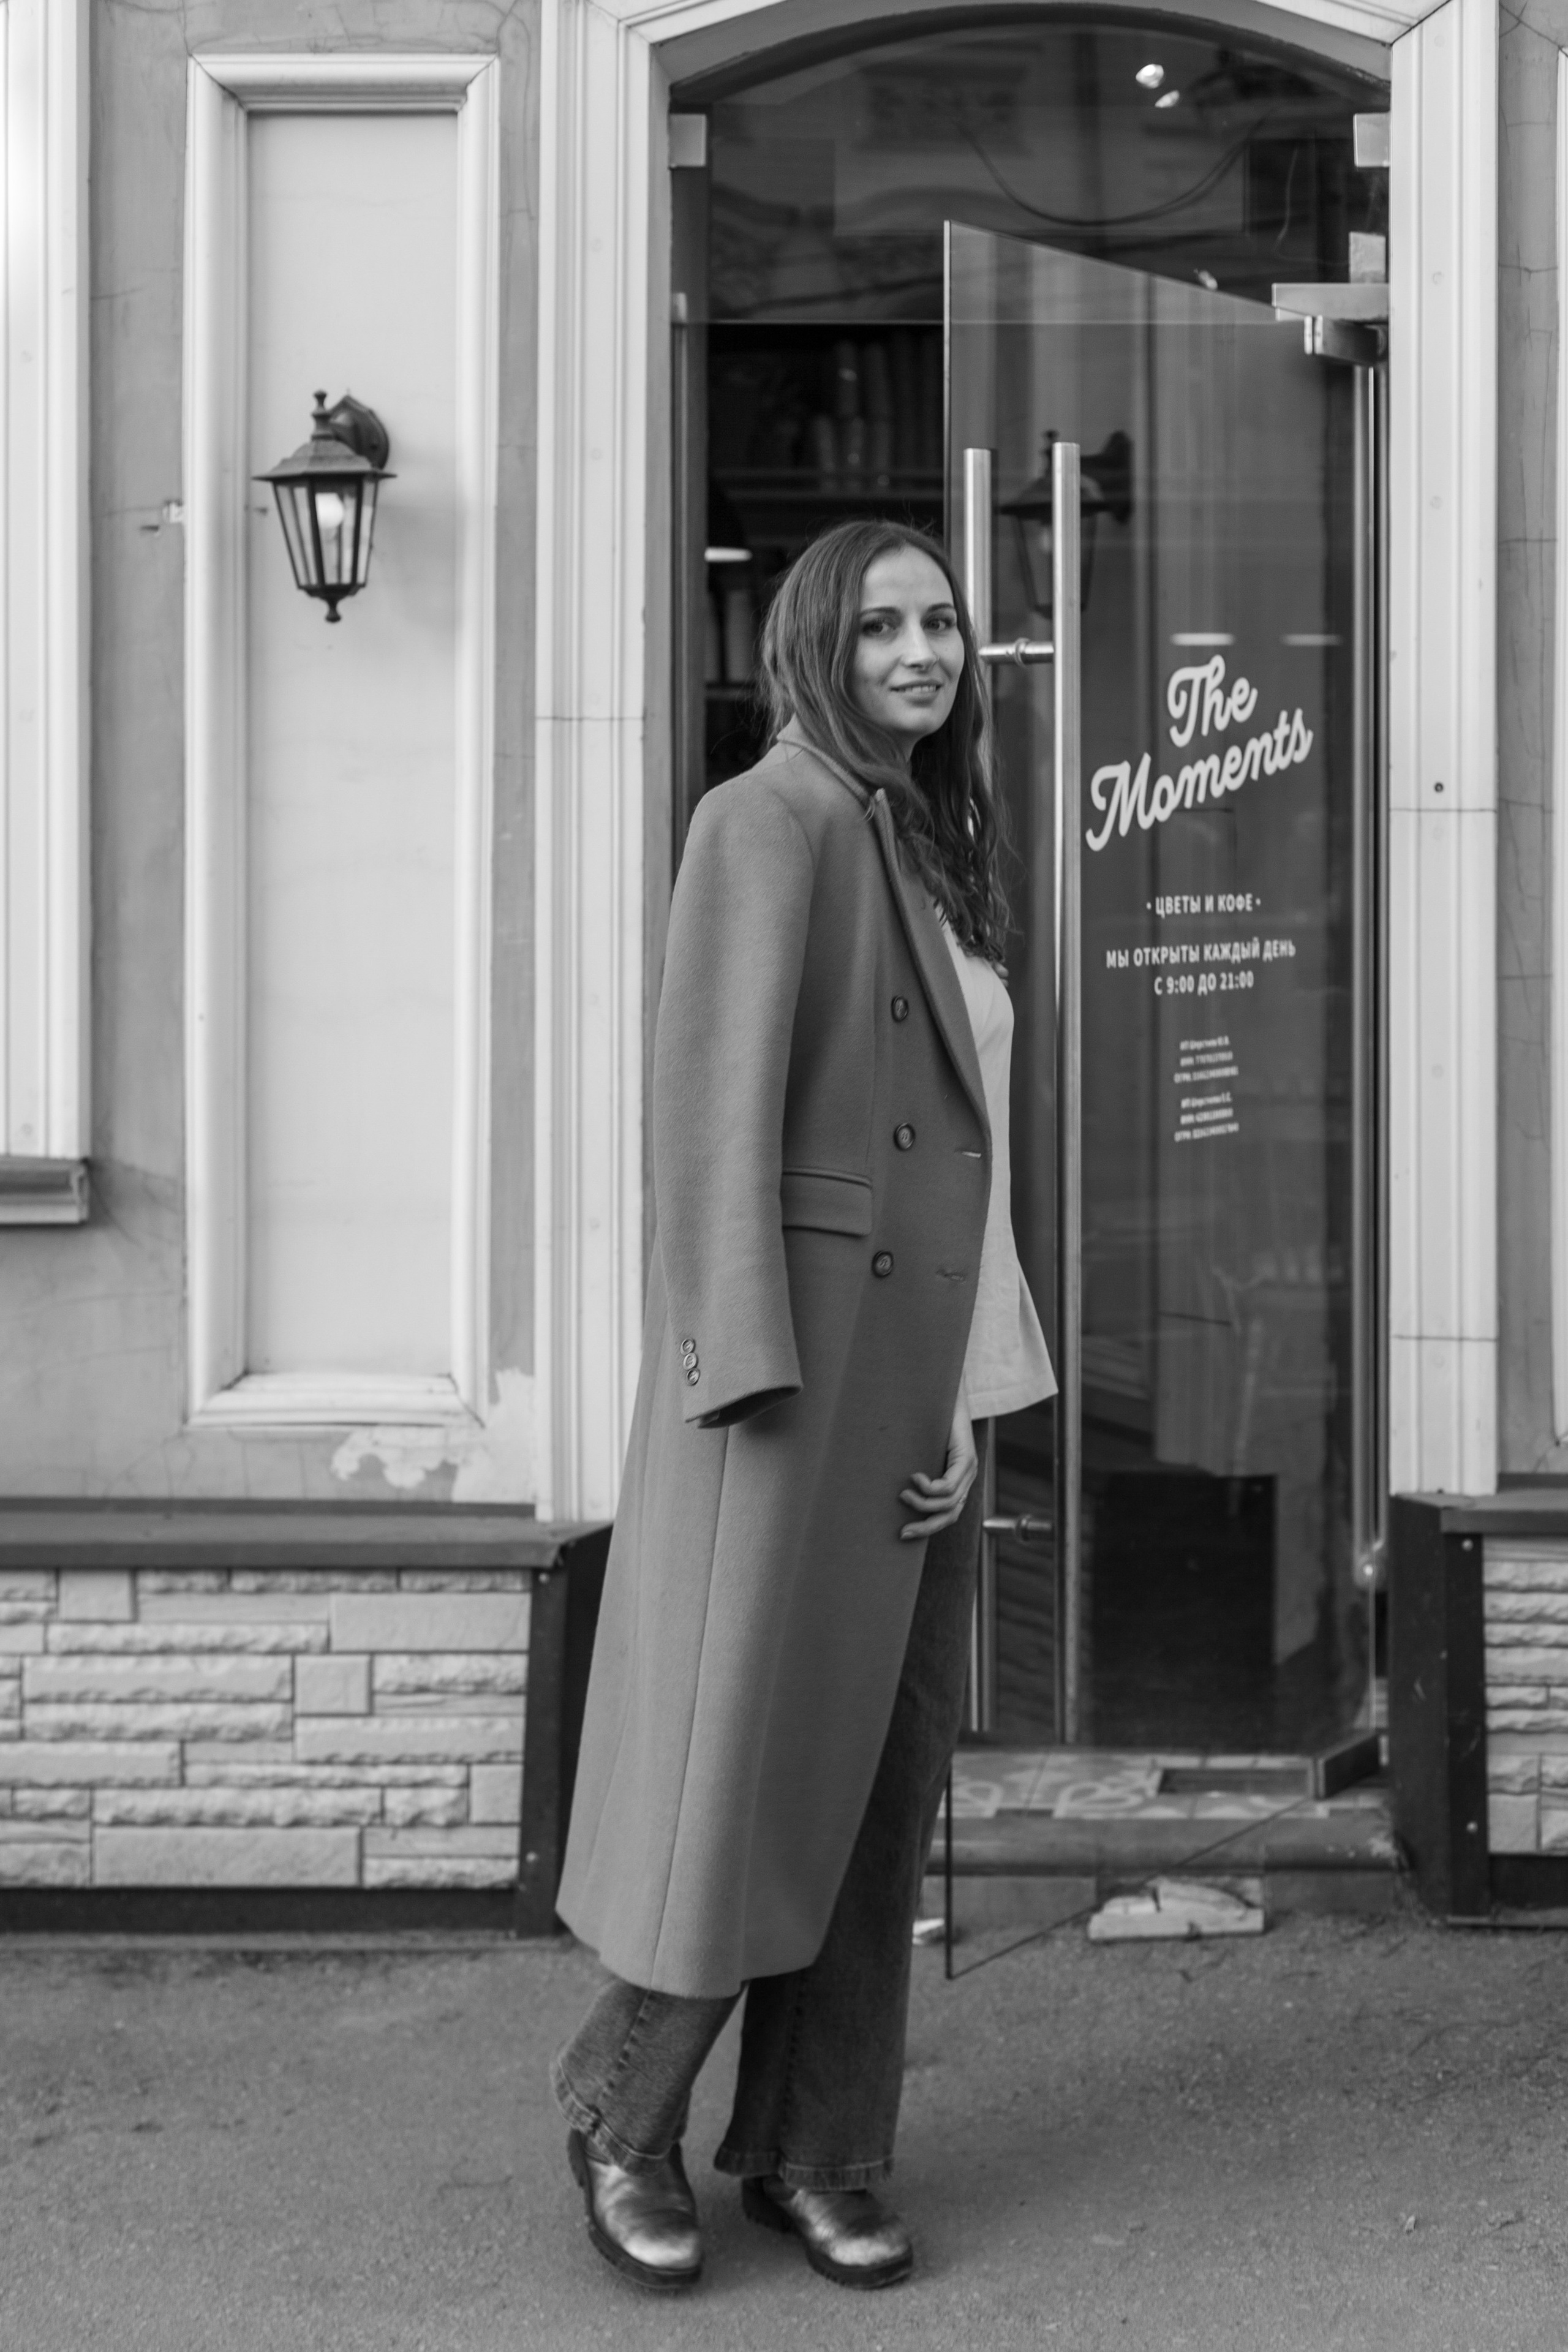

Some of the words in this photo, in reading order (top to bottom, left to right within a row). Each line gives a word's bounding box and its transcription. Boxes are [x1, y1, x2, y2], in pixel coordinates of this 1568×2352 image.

[1167, 654, 1259, 748] The
[1085, 707, 1314, 852] Moments
[1155, 895, 1201, 919] ЦВЕТЫ
[1204, 894, 1215, 913] И
[1217, 892, 1254, 913] КОФЕ
[1106, 949, 1129, 969] МЫ
[1133, 944, 1200, 968] ОТКРЫТЫ
[1203, 936, 1261, 965] КАЖДЫЙ
[1262, 938, 1297, 962] ДЕНЬ
[1153, 976, 1163, 996] С
[1166, 974, 1196, 995] 9:00
[1197, 972, 1218, 997] ДО
[1219, 970, 1255, 991] 21:00
